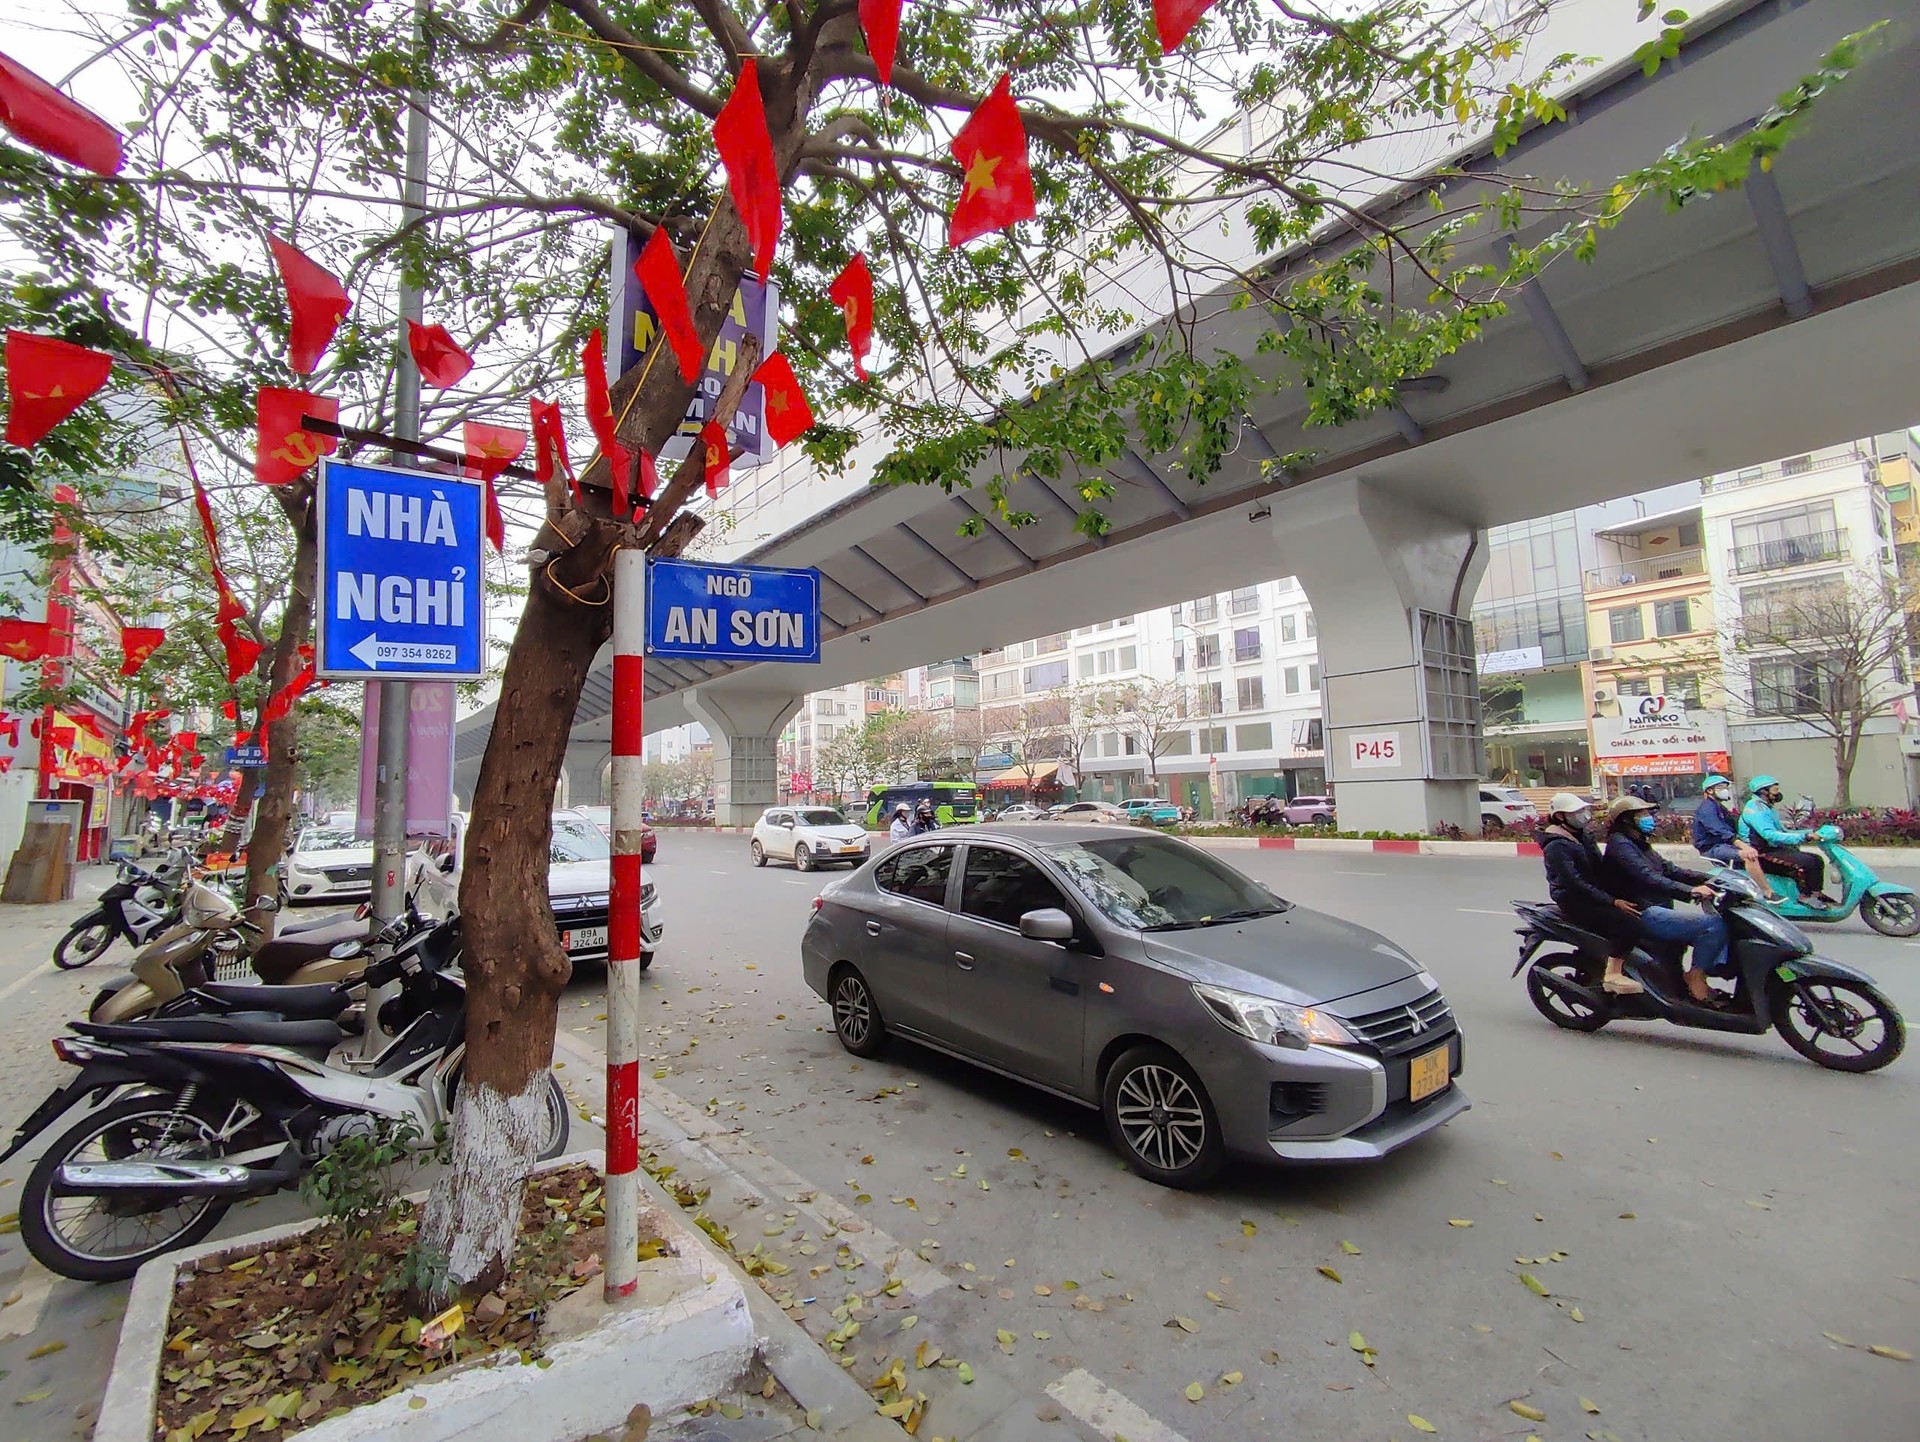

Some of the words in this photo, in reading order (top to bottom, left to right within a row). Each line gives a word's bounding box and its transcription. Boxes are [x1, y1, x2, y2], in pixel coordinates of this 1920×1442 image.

[347, 489, 457, 547] NHÀ
[707, 572, 752, 598] NGÕ
[336, 566, 465, 627] NGHỈ
[664, 606, 718, 646] AN
[730, 607, 804, 649] SƠN
[377, 647, 397, 657] 097
[402, 648, 421, 658] 354
[425, 648, 452, 660] 8262
[1662, 734, 1679, 744] GỐI
[1687, 735, 1706, 744] ĐỆM
[1356, 741, 1395, 760] P45
[1623, 764, 1648, 774] LỚN
[1649, 765, 1673, 773] NHẤT
[581, 929, 597, 938] 89A
[573, 937, 604, 948] 324.40
